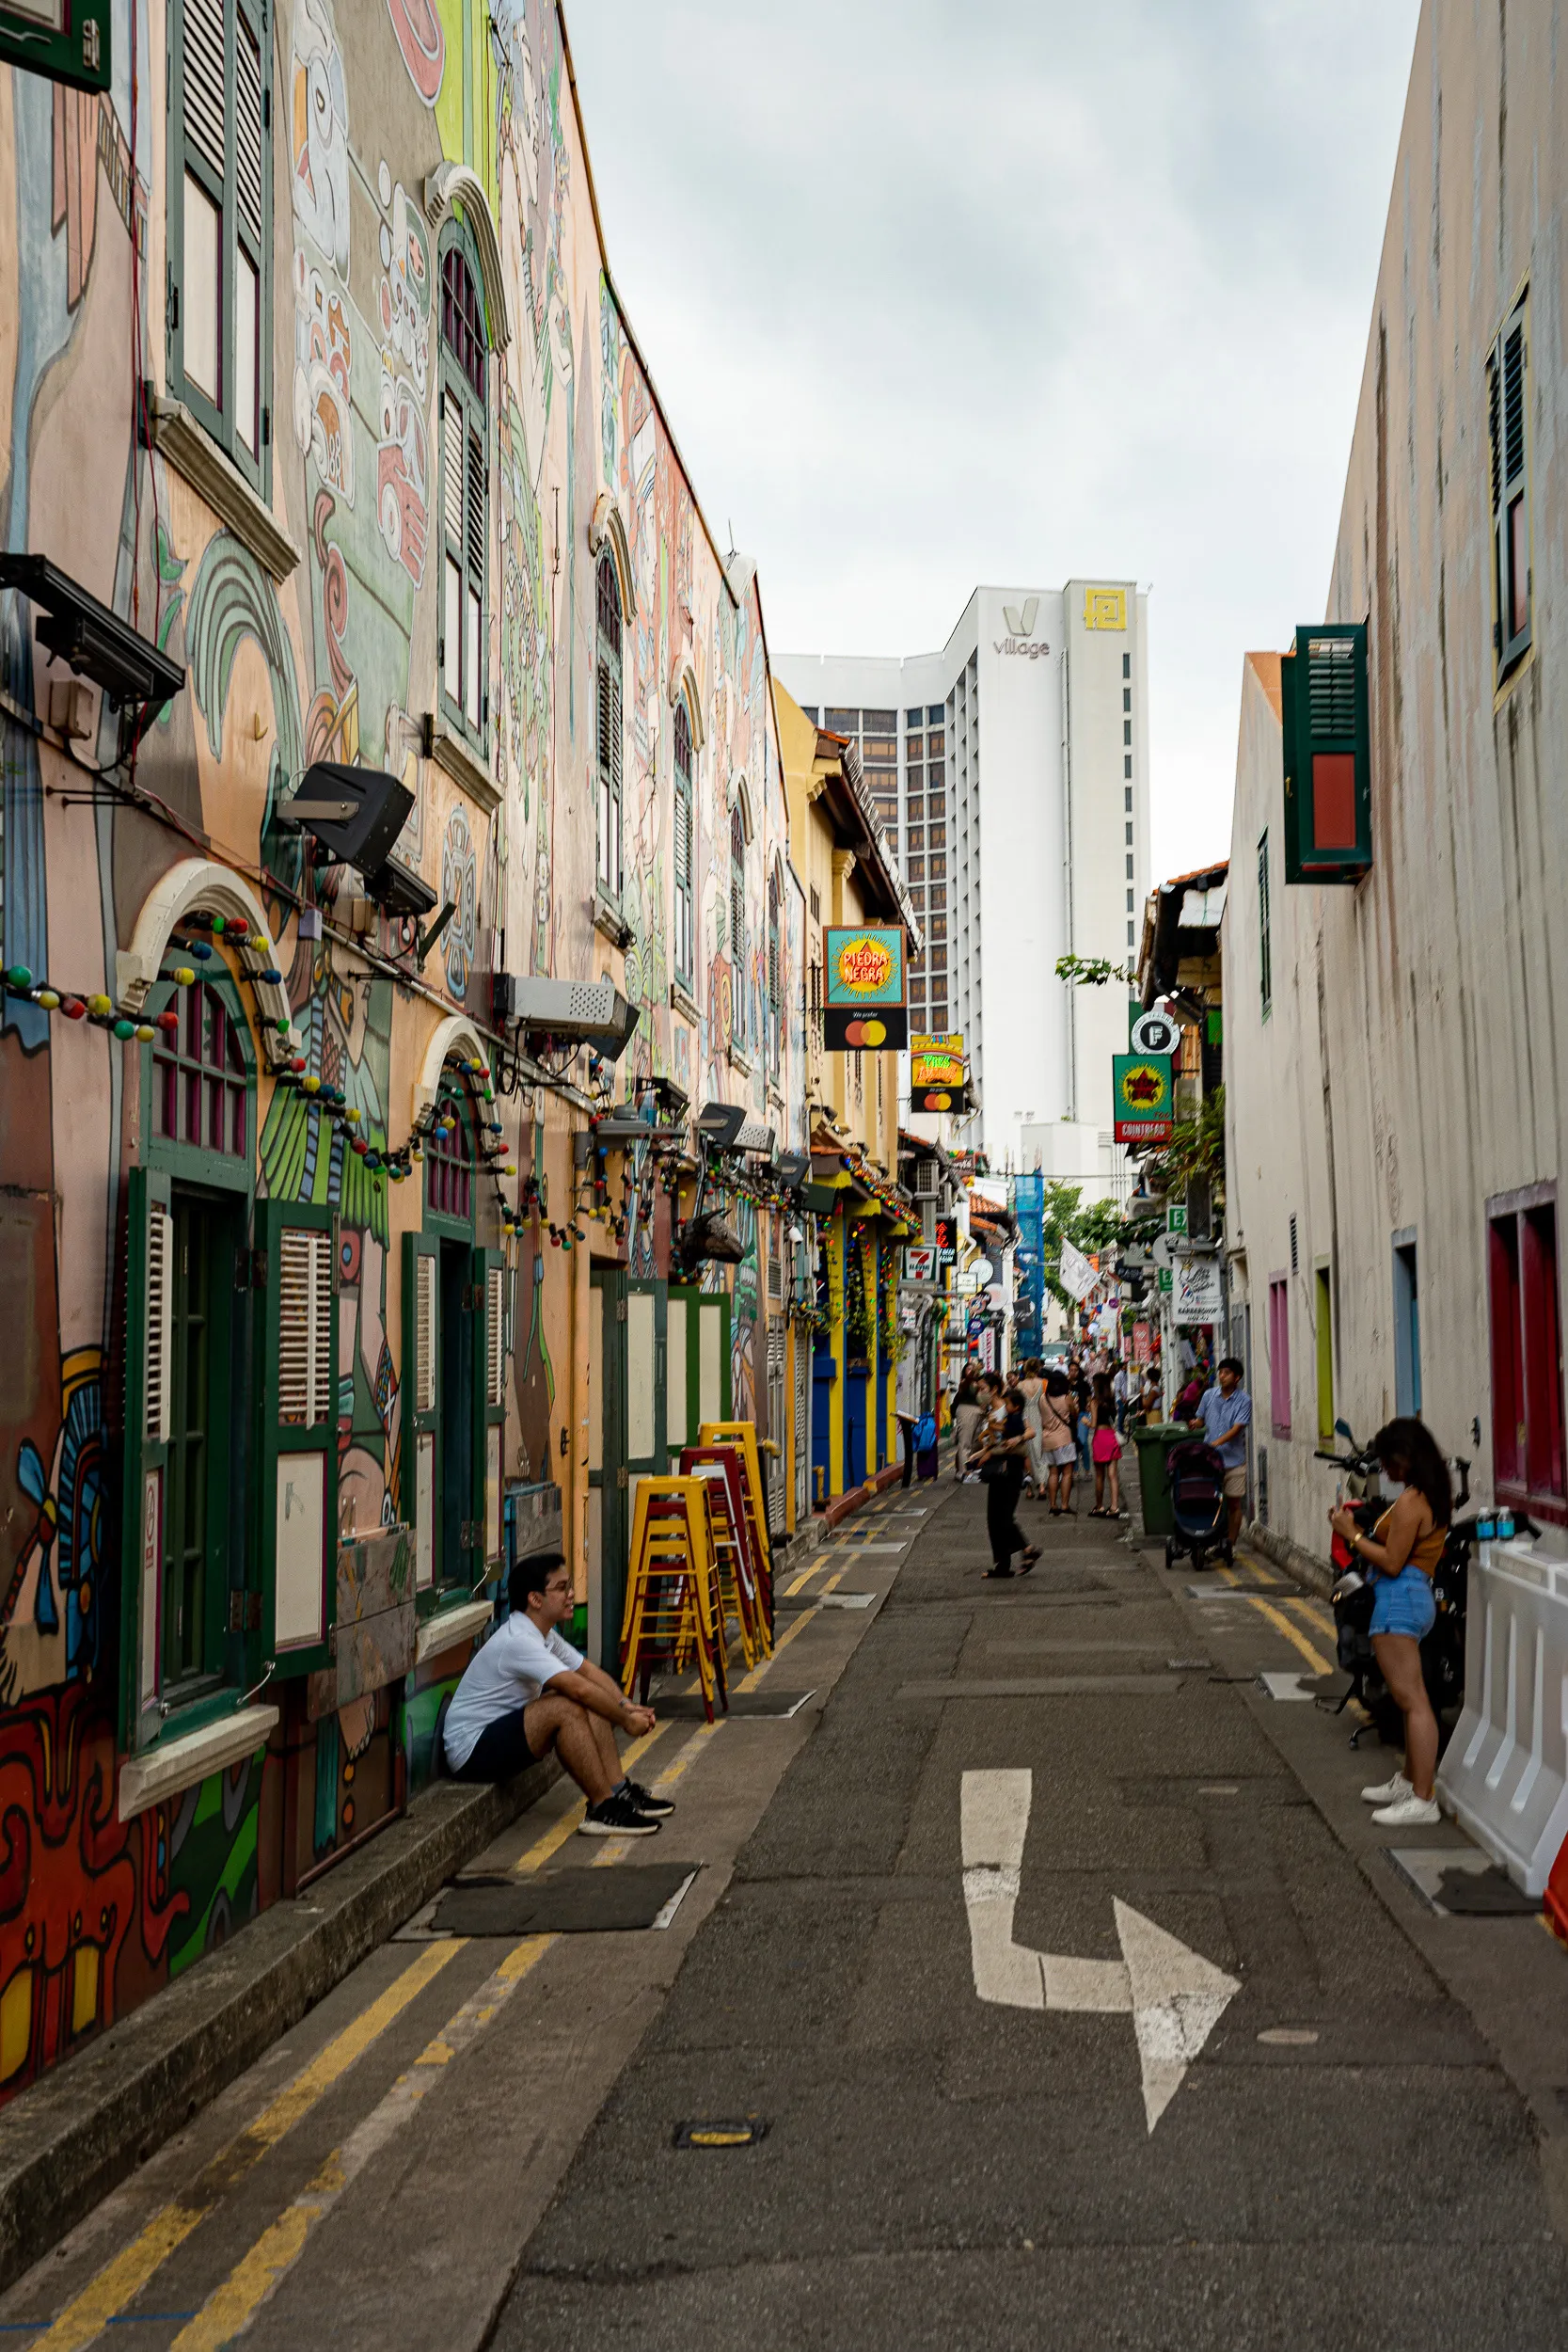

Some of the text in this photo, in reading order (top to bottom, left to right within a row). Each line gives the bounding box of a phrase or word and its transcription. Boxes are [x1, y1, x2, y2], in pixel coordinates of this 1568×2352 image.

[993, 637, 1050, 659] village
[844, 951, 888, 966] PIEDRA
[845, 967, 883, 982] NEGRA
